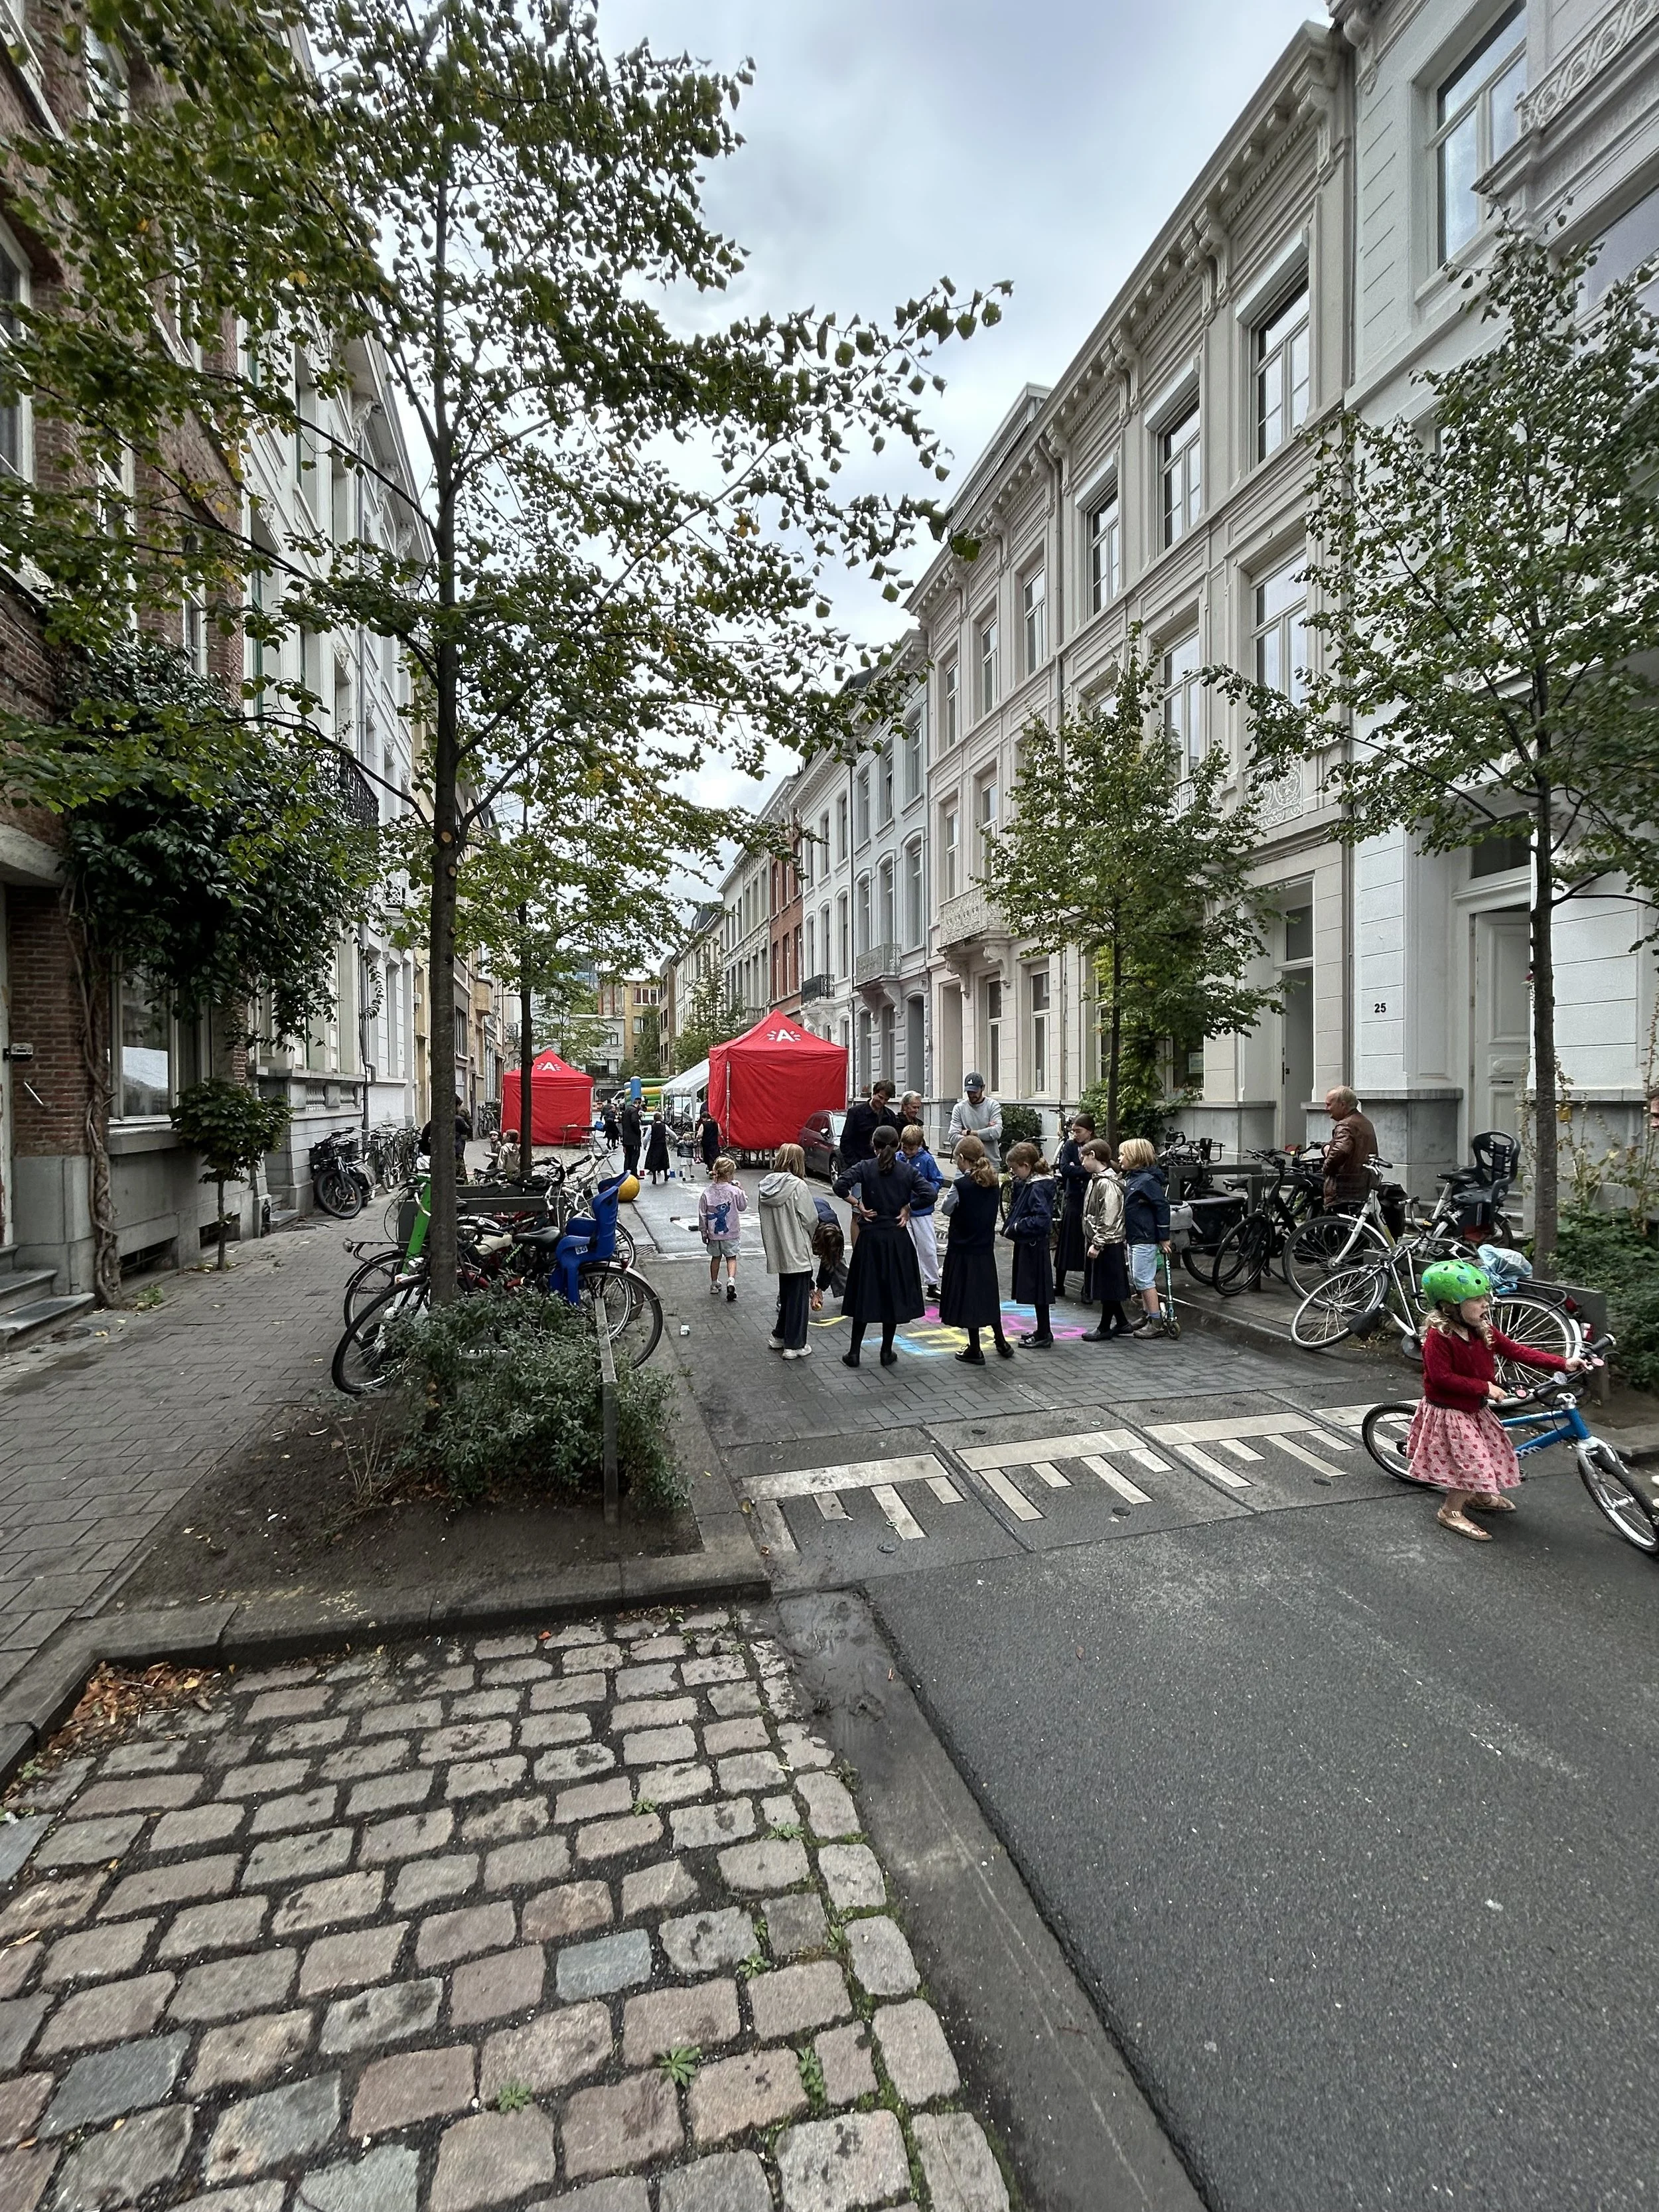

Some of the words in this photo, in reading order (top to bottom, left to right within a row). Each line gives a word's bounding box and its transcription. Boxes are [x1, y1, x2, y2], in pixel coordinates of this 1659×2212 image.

[1374, 1003, 1386, 1013] 25
[776, 1029, 796, 1042] A
[541, 1061, 556, 1071] A
